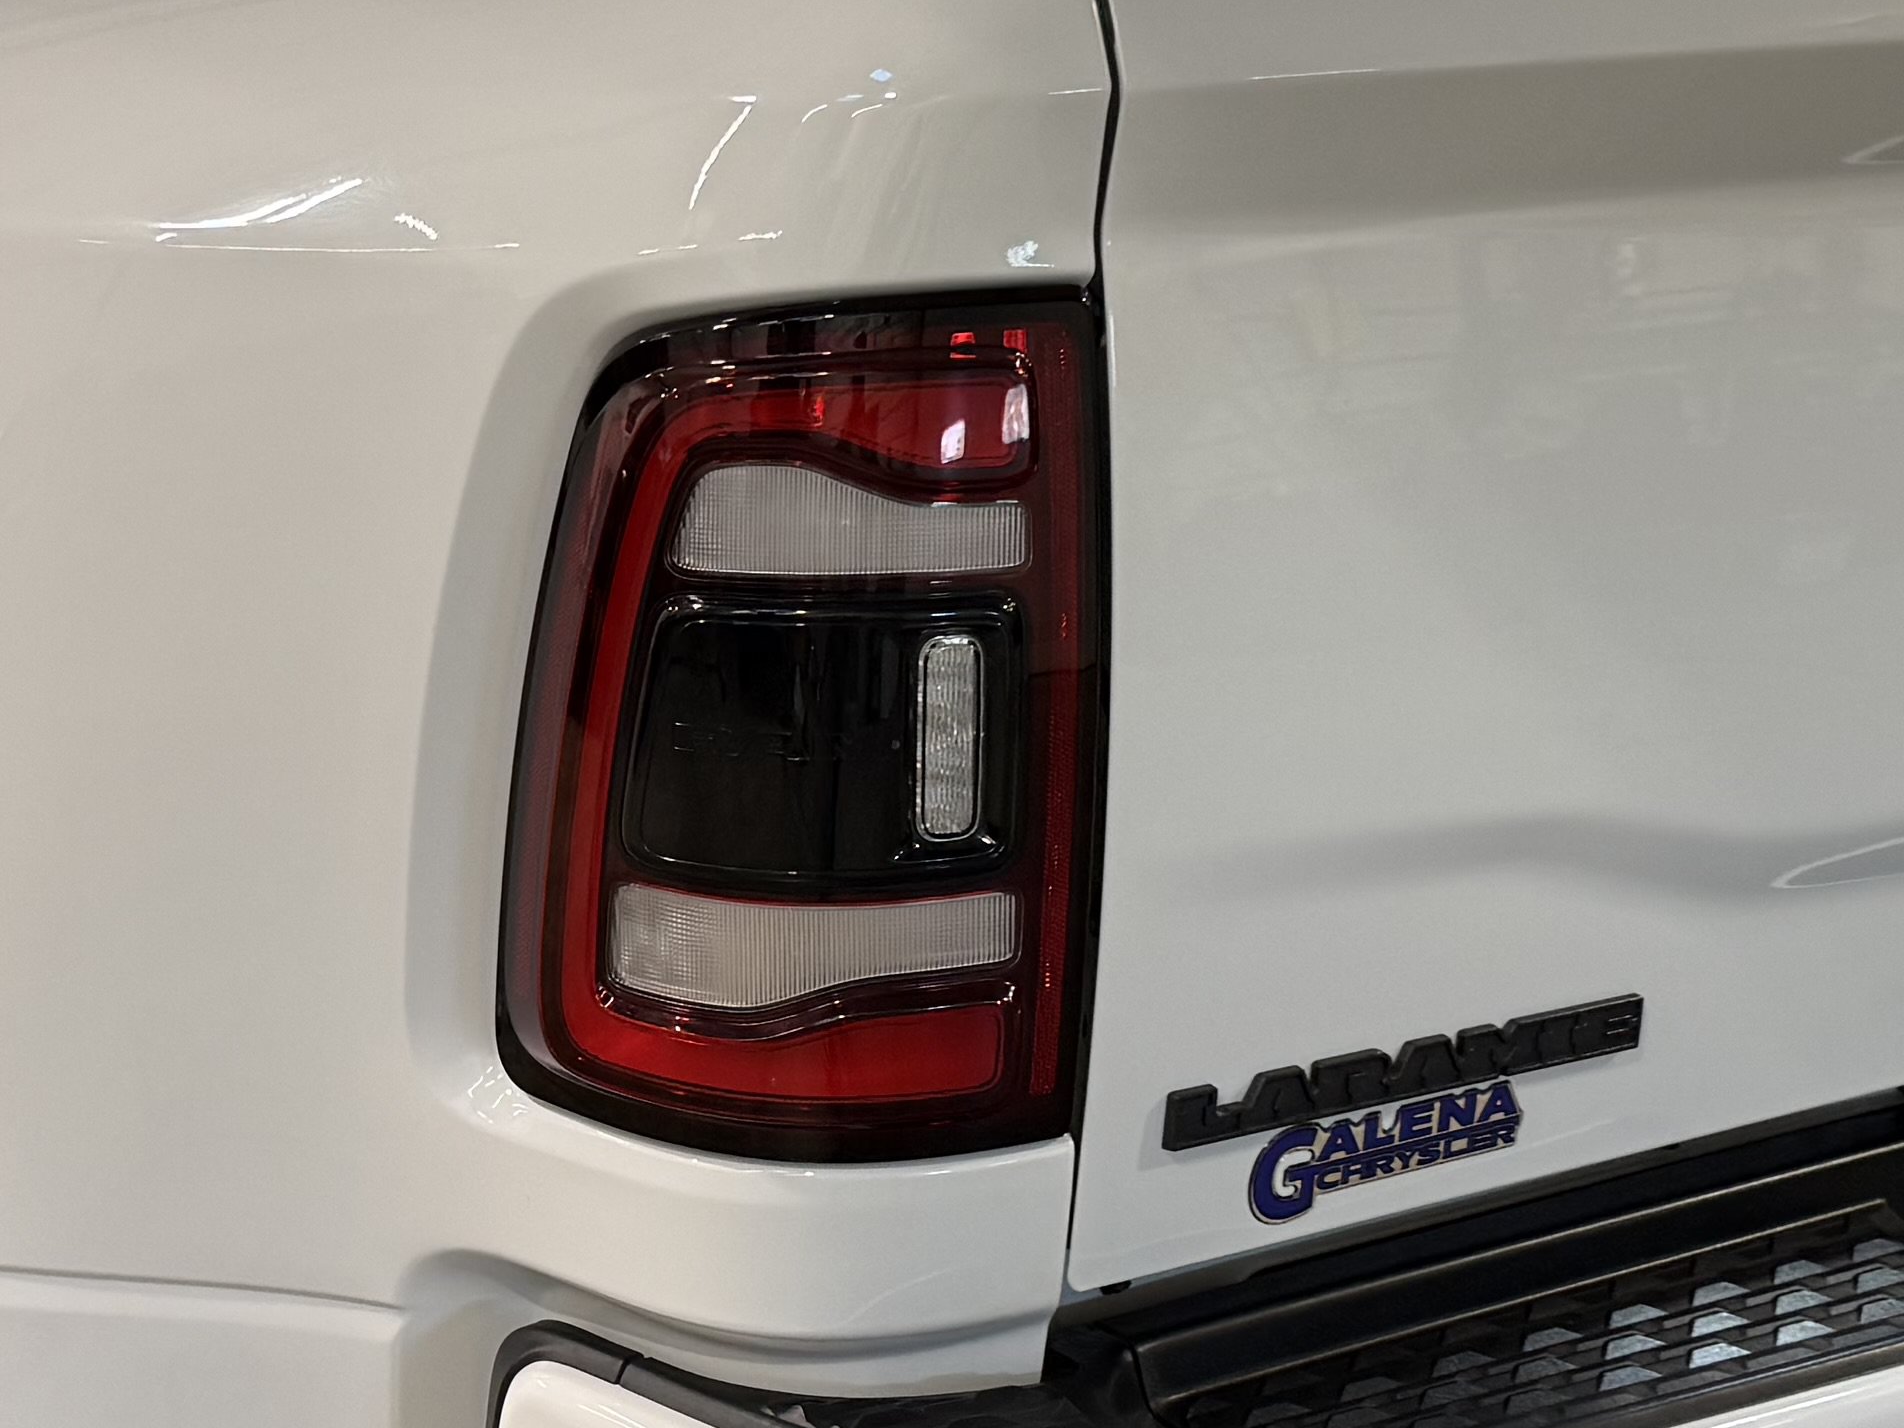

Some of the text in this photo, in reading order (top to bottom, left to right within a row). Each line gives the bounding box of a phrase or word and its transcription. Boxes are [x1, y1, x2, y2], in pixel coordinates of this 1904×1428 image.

[1161, 992, 1644, 1152] LARAMIE
[1247, 1079, 1520, 1226] GALENA
[1316, 1124, 1516, 1191] CHRYSLER
